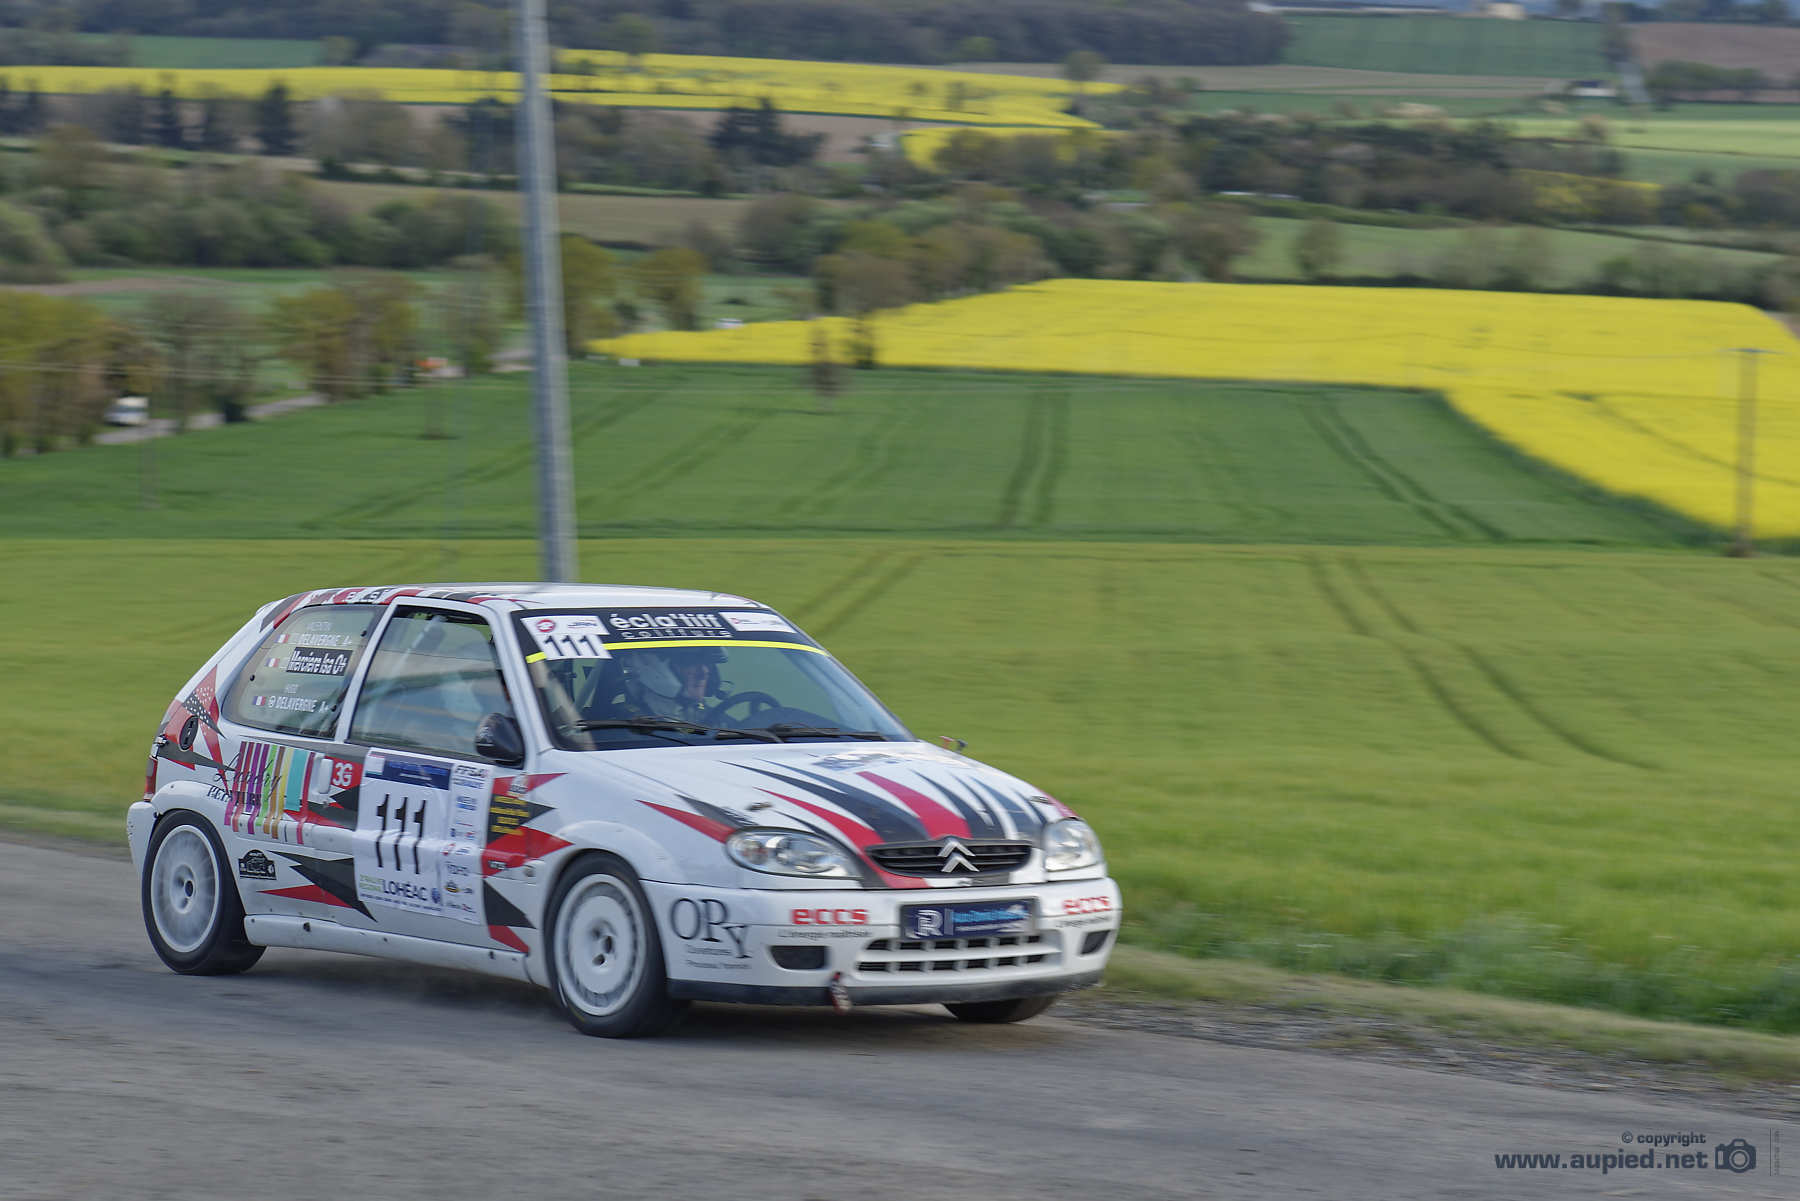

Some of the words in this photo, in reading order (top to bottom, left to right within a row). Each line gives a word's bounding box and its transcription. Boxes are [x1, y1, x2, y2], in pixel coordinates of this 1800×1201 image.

[621, 629, 732, 639] coiffure
[543, 635, 600, 657] 111
[332, 762, 353, 786] 3G
[376, 794, 427, 875] 111
[382, 879, 428, 902] LOHÉAC
[1062, 896, 1110, 915] eccs
[790, 909, 869, 925] eccs
